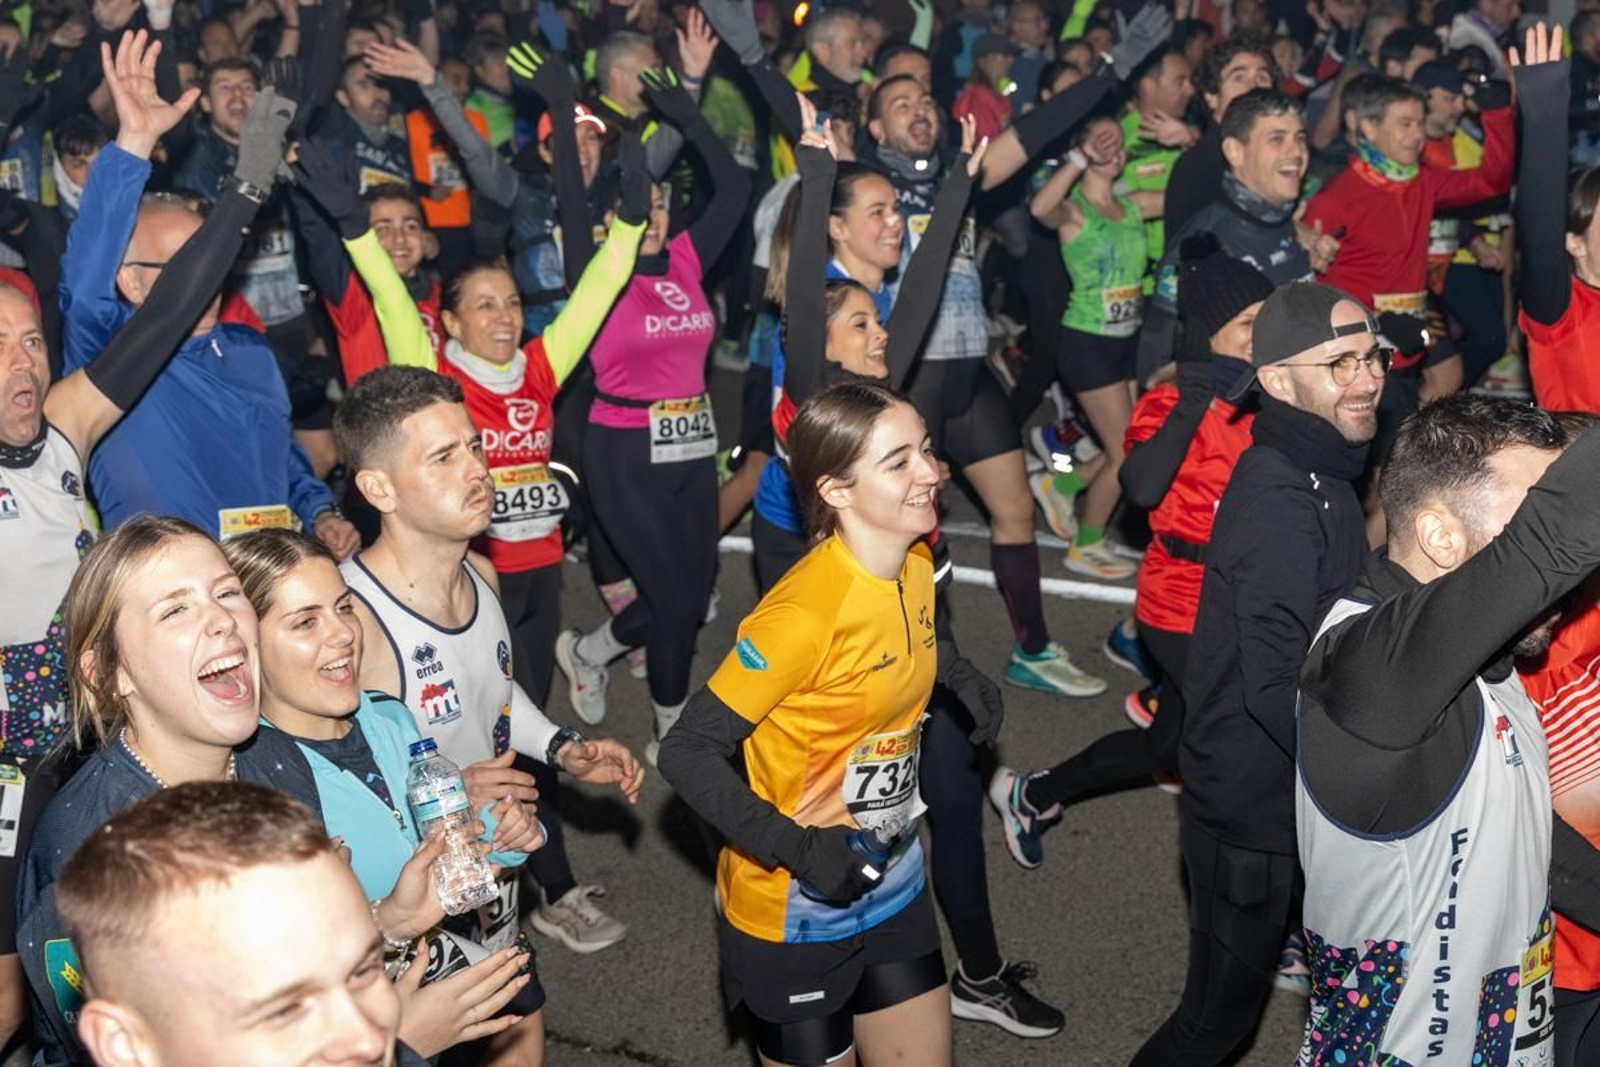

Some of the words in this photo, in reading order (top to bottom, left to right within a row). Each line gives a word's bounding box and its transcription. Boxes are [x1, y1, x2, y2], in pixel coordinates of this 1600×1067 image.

[659, 412, 711, 438] 8042
[494, 483, 561, 514] 8493
[875, 738, 897, 755] 42
[856, 756, 916, 800] 732
[1528, 972, 1554, 1029] 5
